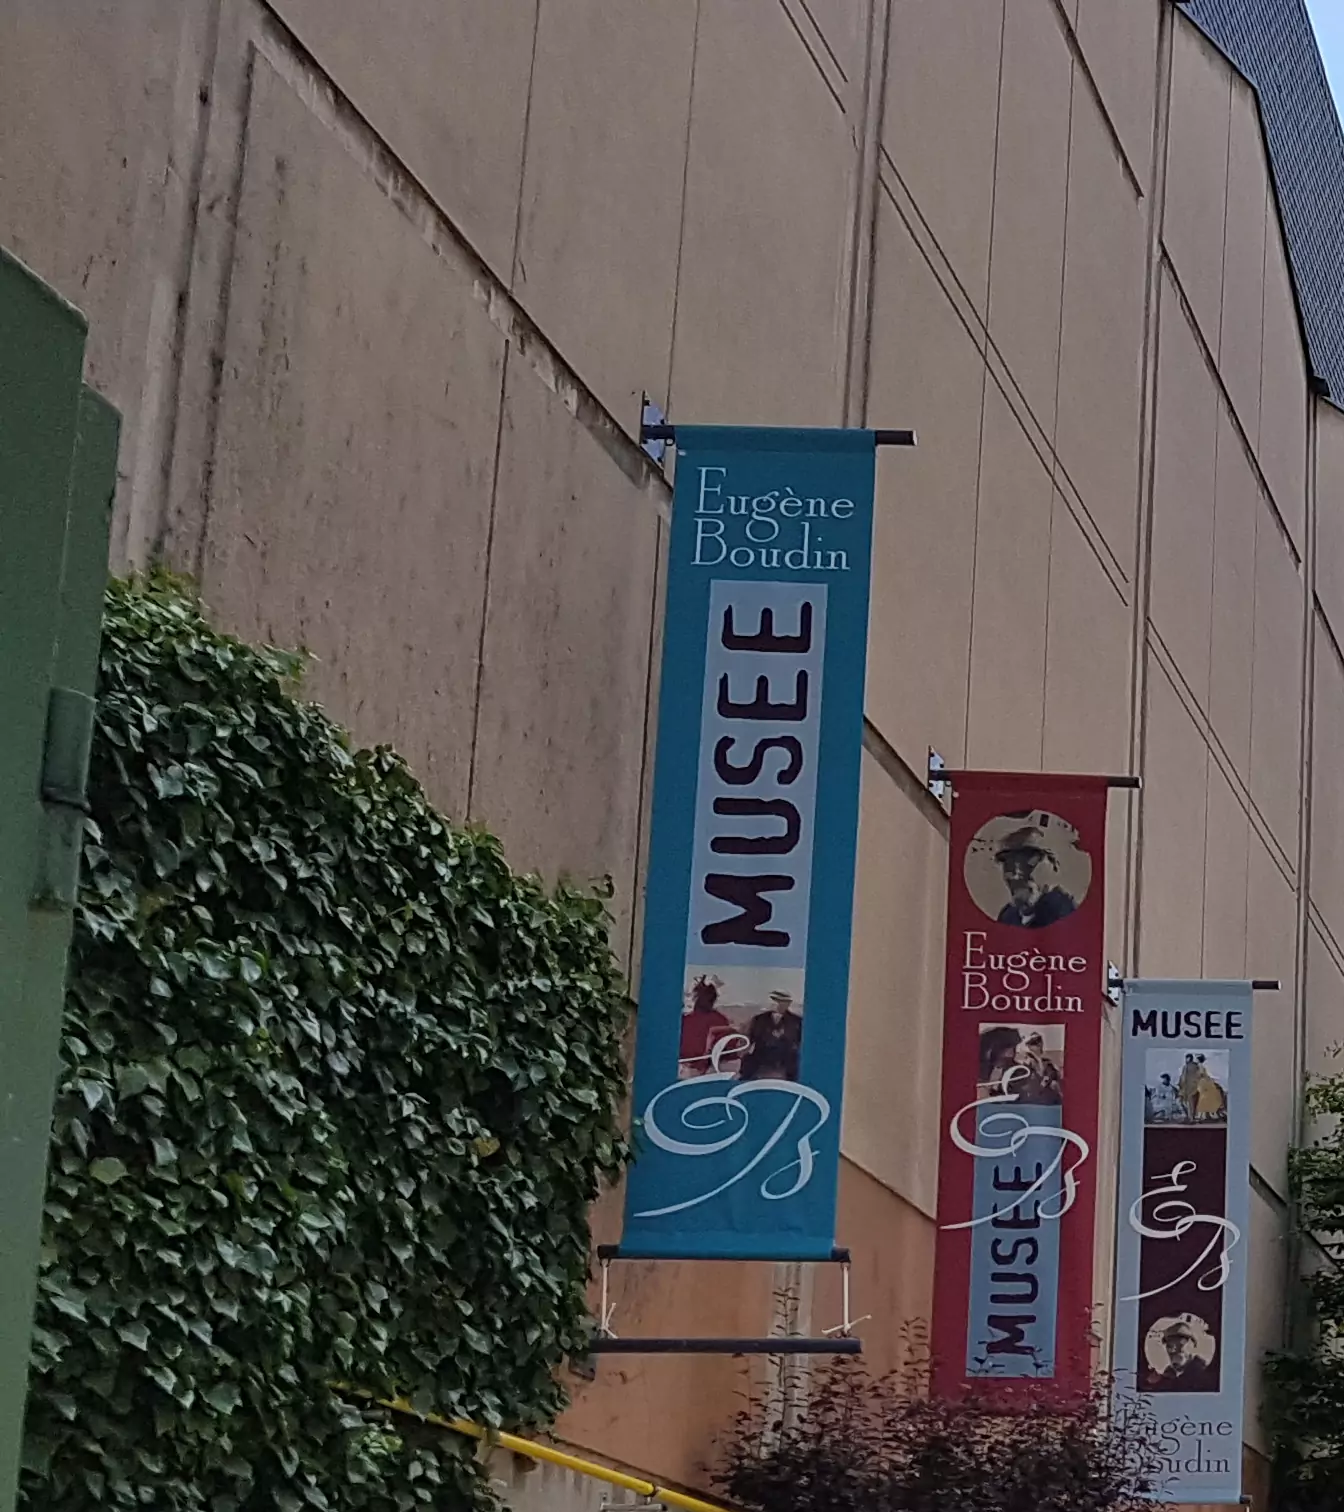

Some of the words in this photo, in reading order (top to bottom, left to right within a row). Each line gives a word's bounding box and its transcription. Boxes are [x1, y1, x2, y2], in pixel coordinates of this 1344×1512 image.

[694, 467, 856, 543] Eugène
[690, 518, 851, 571] Boudin
[701, 601, 813, 947] MUSEE
[962, 931, 1087, 991] Eugène
[960, 971, 1085, 1013] Boudin
[1131, 1009, 1244, 1040] MUSEE
[985, 1161, 1044, 1356] MUSEE
